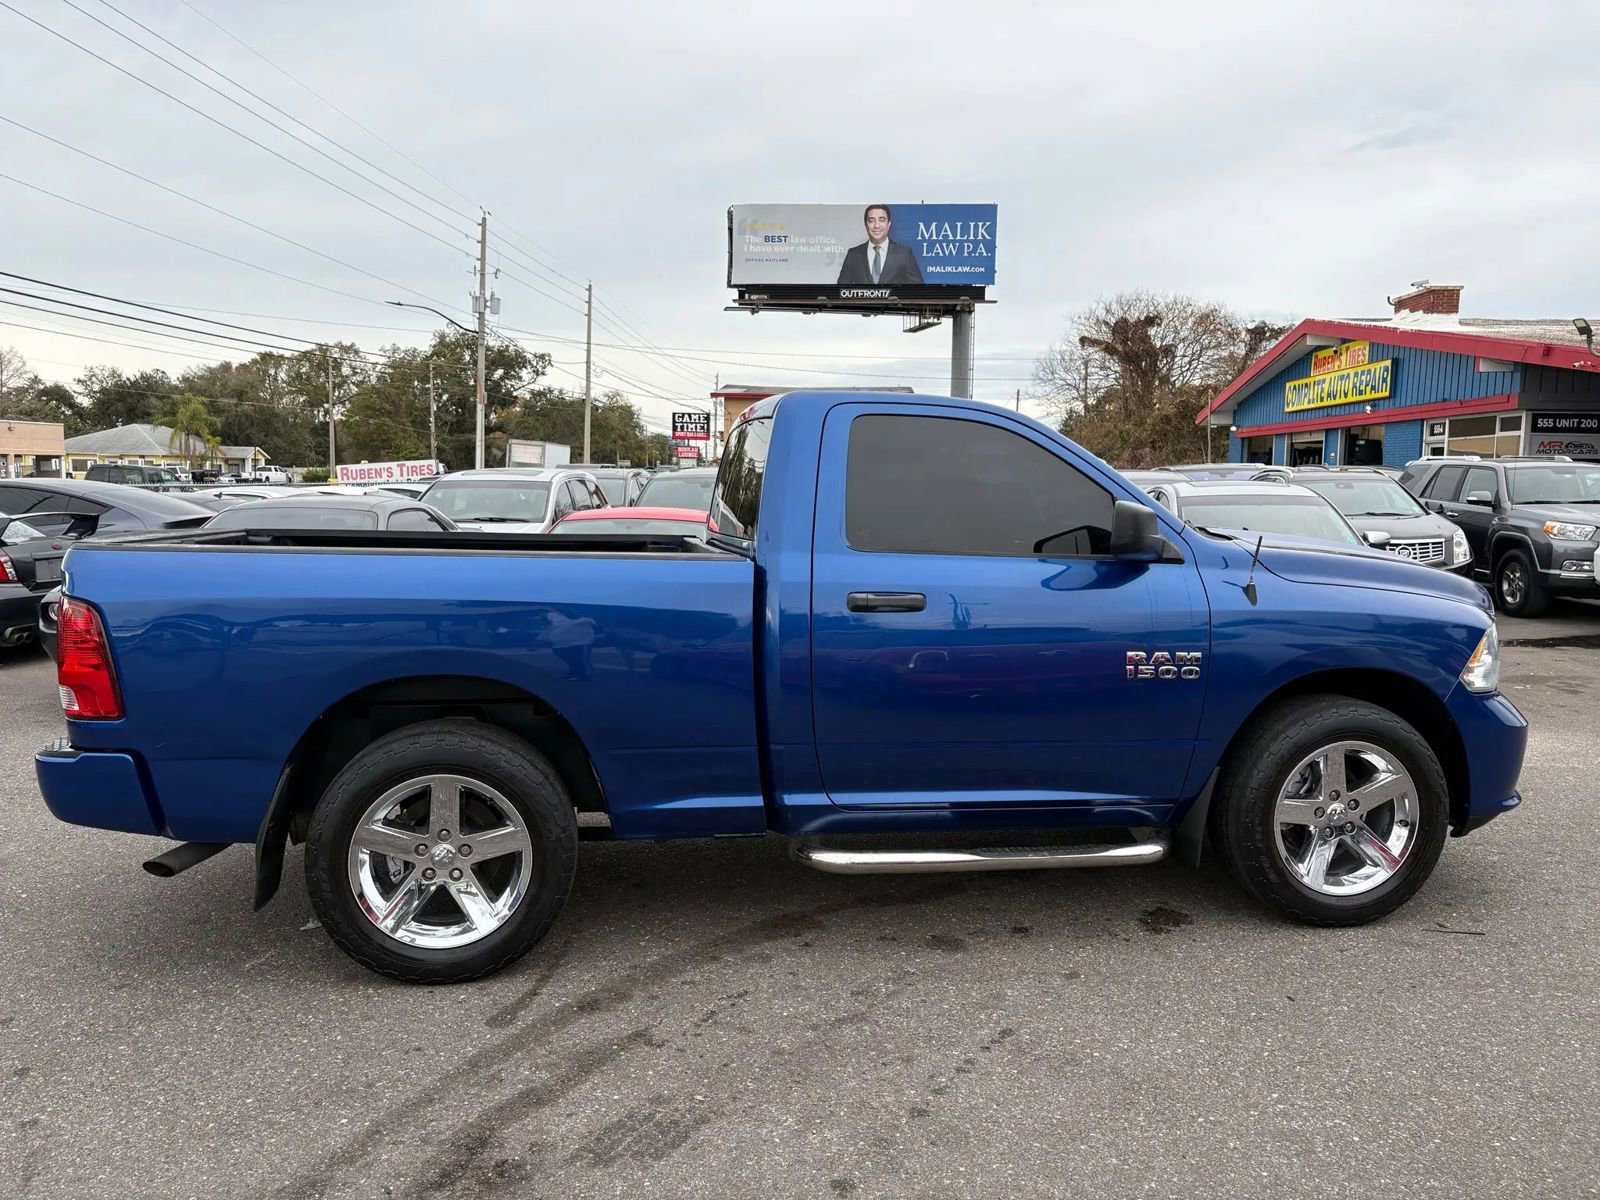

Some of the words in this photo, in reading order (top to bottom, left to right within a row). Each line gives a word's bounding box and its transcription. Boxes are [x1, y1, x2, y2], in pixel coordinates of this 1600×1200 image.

[916, 222, 992, 240] MALIK
[764, 235, 789, 243] BEST
[922, 243, 960, 256] LAW
[963, 243, 992, 256] P.A.
[1345, 346, 1367, 367] TIRES
[1327, 373, 1350, 401] AUTO
[1352, 366, 1390, 397] REPAIR
[675, 413, 708, 423] GAME
[1537, 418, 1554, 427] 555
[1556, 418, 1580, 428] UNIT
[1580, 419, 1598, 428] 200
[675, 423, 708, 432] TIME!
[340, 466, 394, 481] RUBEN'S
[397, 463, 434, 478] TIRES
[1126, 651, 1202, 664] RAM
[1126, 665, 1201, 679] 1500
